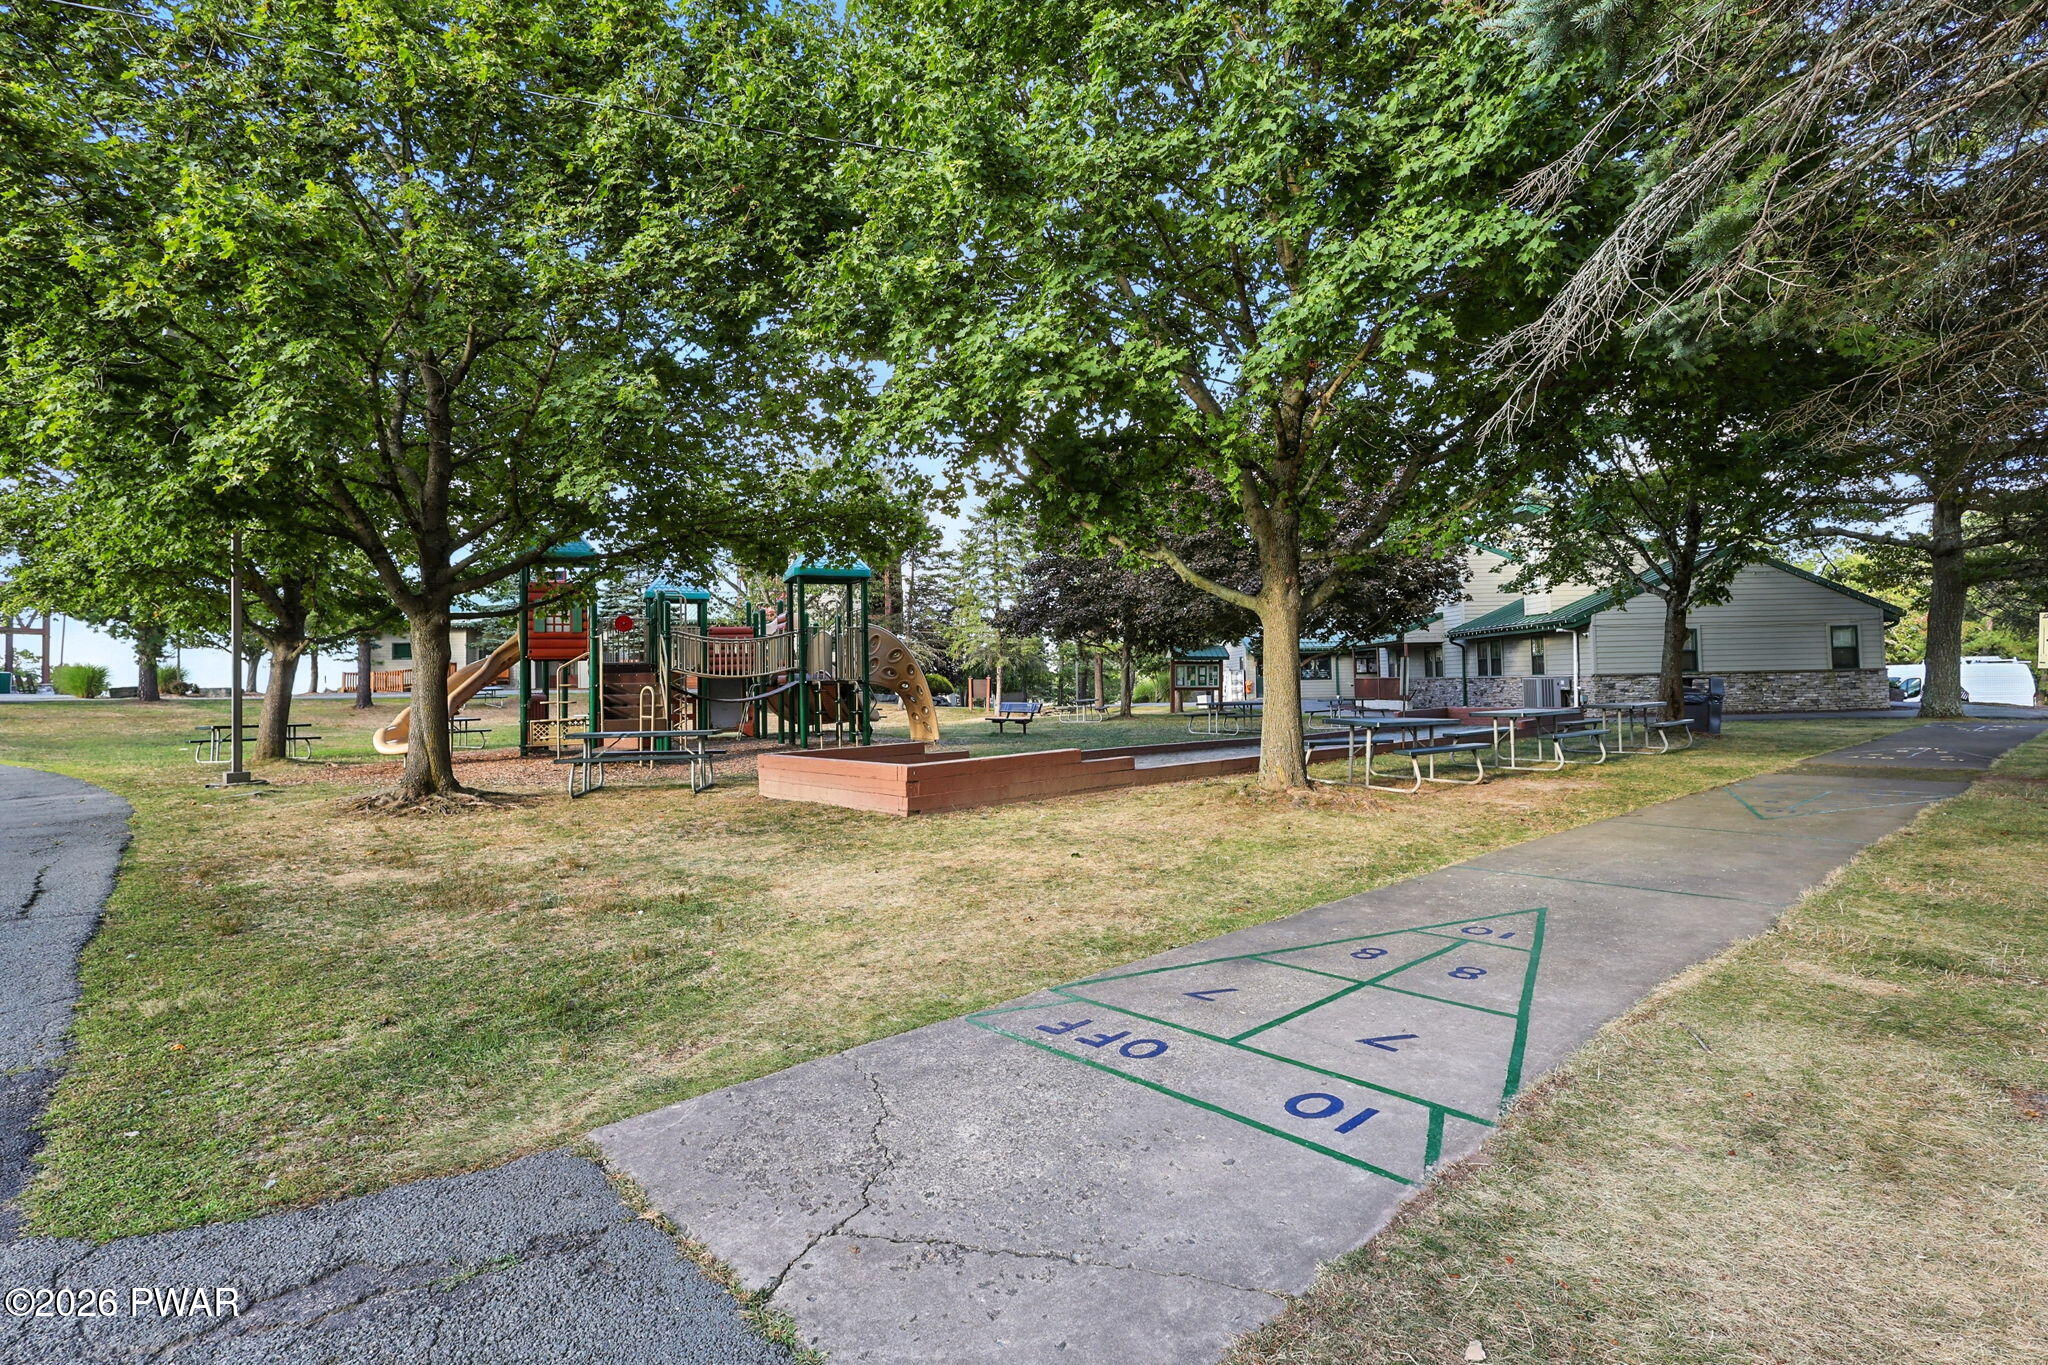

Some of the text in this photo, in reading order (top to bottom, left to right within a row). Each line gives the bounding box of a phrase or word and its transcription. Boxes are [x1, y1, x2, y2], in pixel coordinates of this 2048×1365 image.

[1461, 926, 1516, 939] 10
[1350, 947, 1388, 960] 8
[1447, 966, 1488, 980] 8
[1182, 988, 1239, 1001] 7
[1355, 1033, 1420, 1052] 7
[1035, 1018, 1380, 1134] 10 OFF
